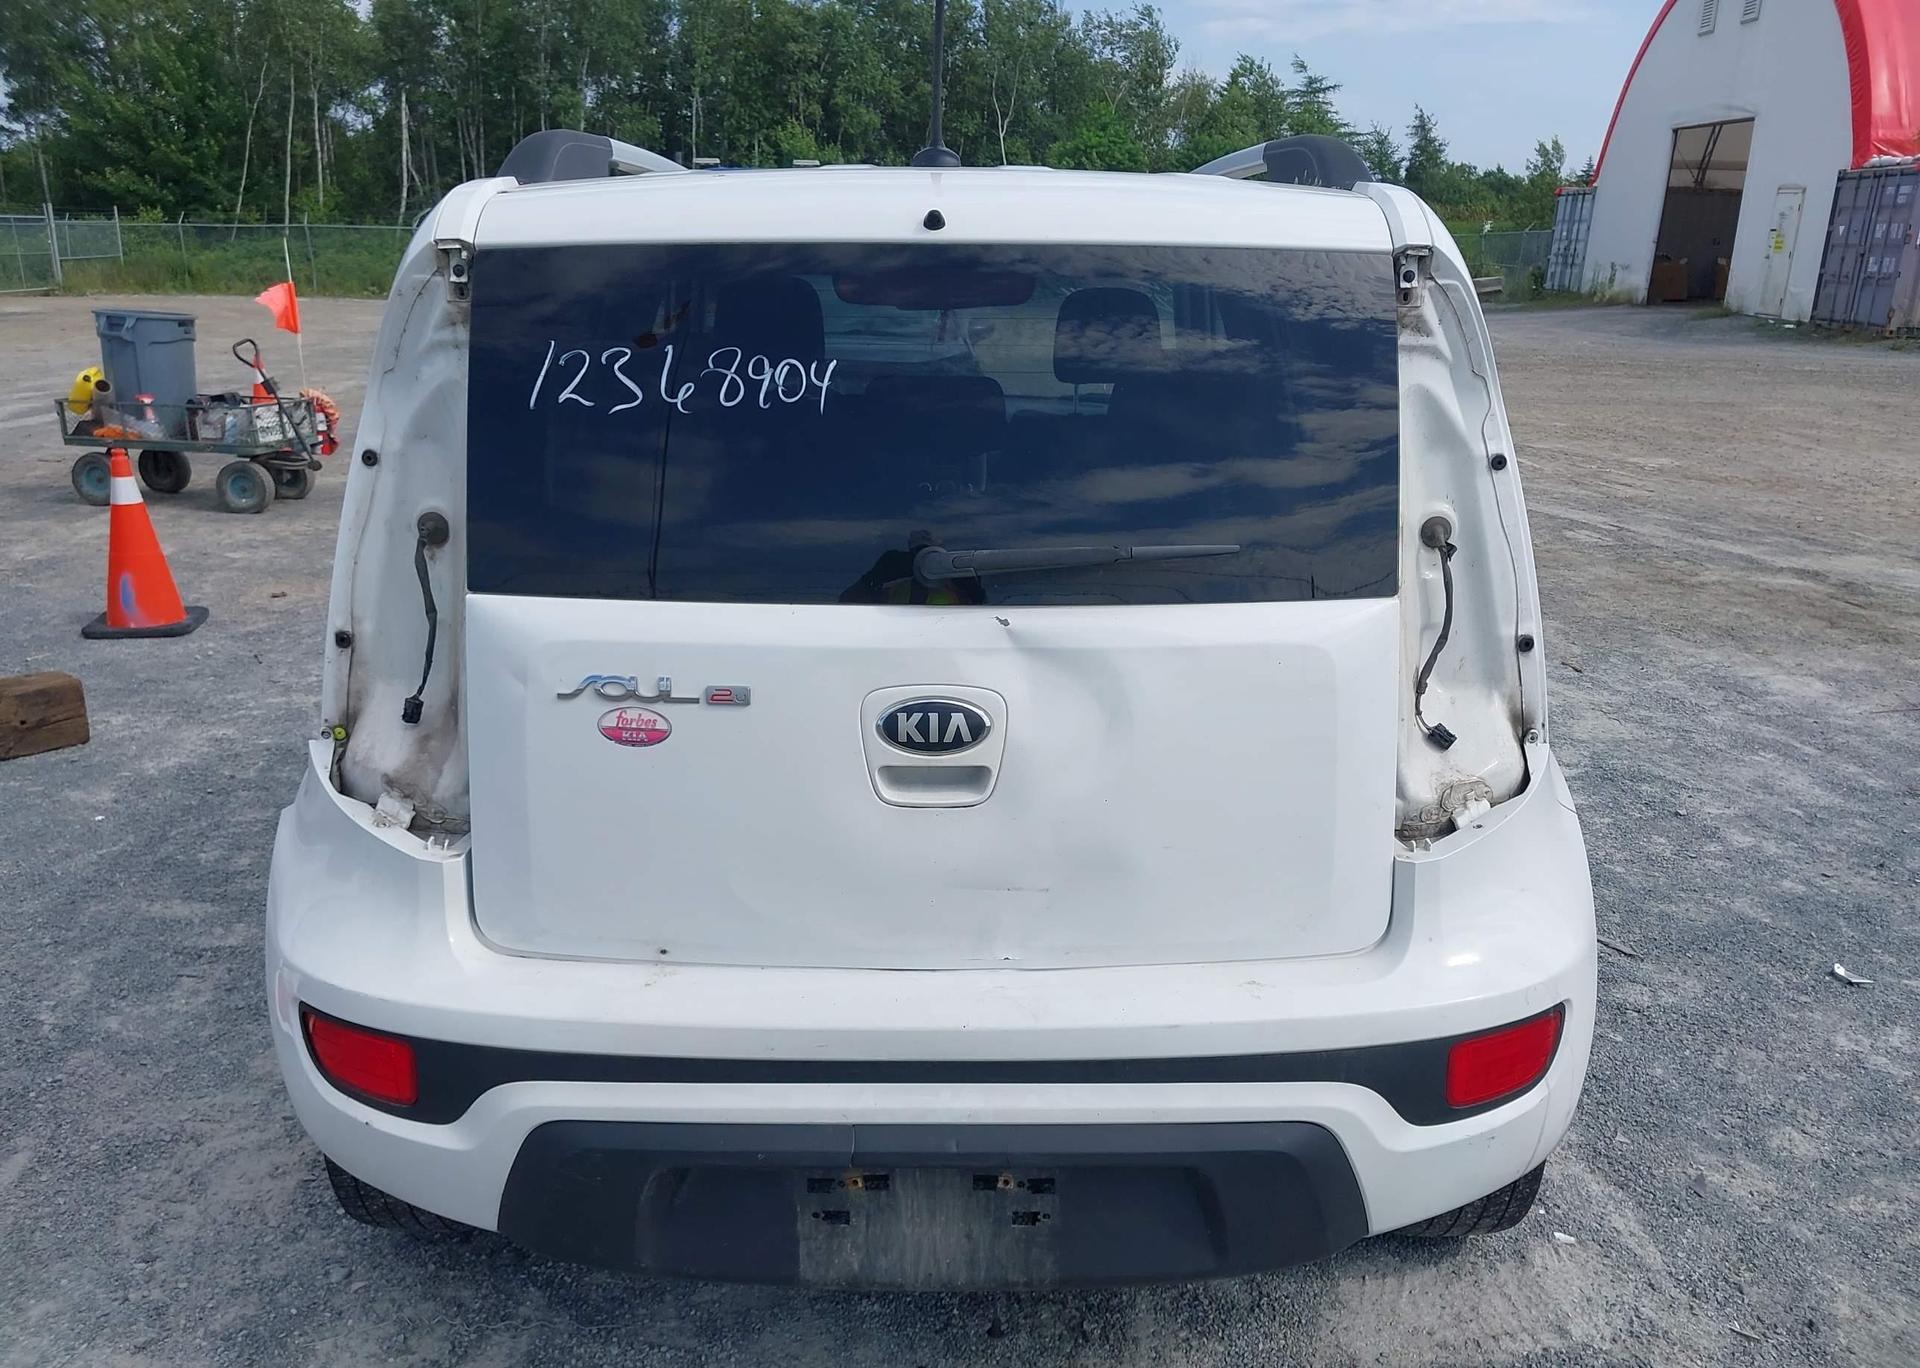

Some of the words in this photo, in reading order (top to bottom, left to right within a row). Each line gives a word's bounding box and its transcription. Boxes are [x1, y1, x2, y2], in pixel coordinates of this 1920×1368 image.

[530, 340, 838, 415] 12368904
[615, 709, 658, 729] forbes
[896, 712, 973, 743] KIA
